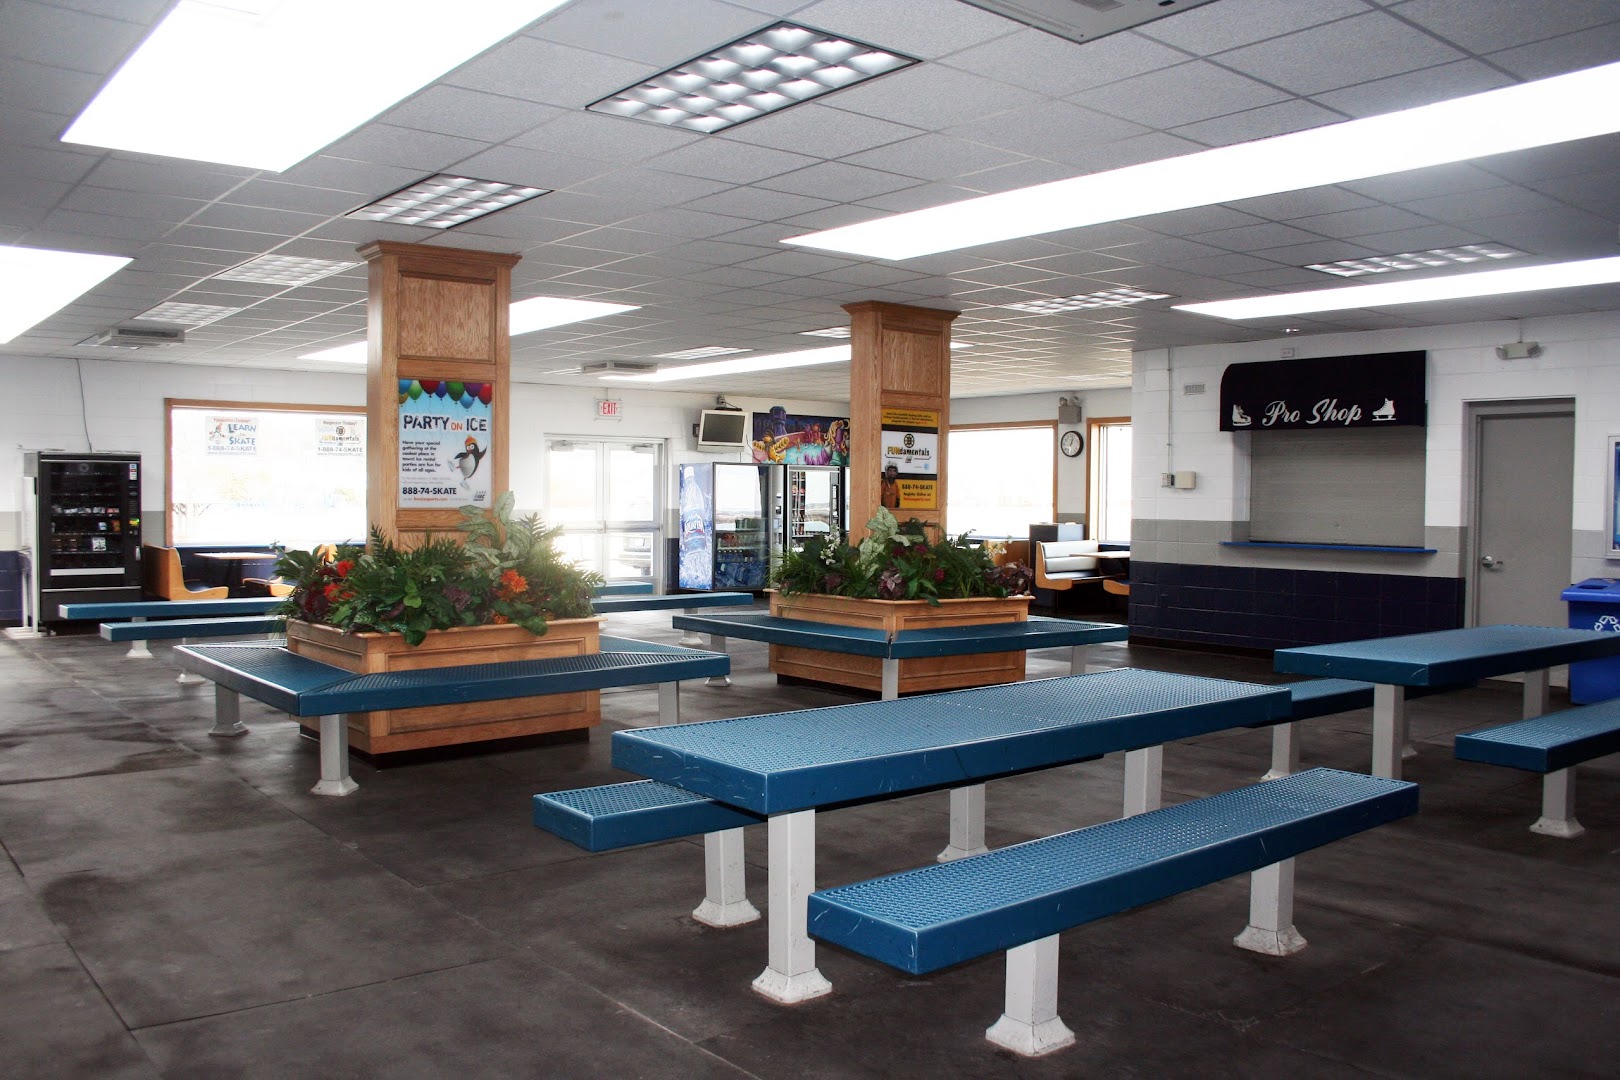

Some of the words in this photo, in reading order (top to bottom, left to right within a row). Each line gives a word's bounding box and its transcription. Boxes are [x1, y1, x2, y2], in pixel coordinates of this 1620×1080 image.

[602, 402, 617, 415] EXIT
[1262, 400, 1300, 427] Pro
[1305, 398, 1362, 426] Shop
[403, 414, 450, 430] PARTY
[451, 422, 463, 431] ON
[466, 418, 487, 431] ICE
[228, 423, 256, 433] LEARN
[229, 436, 256, 446] SKATE
[887, 446, 930, 456] FUNdamentals
[402, 487, 457, 495] 888-74-SKATE
